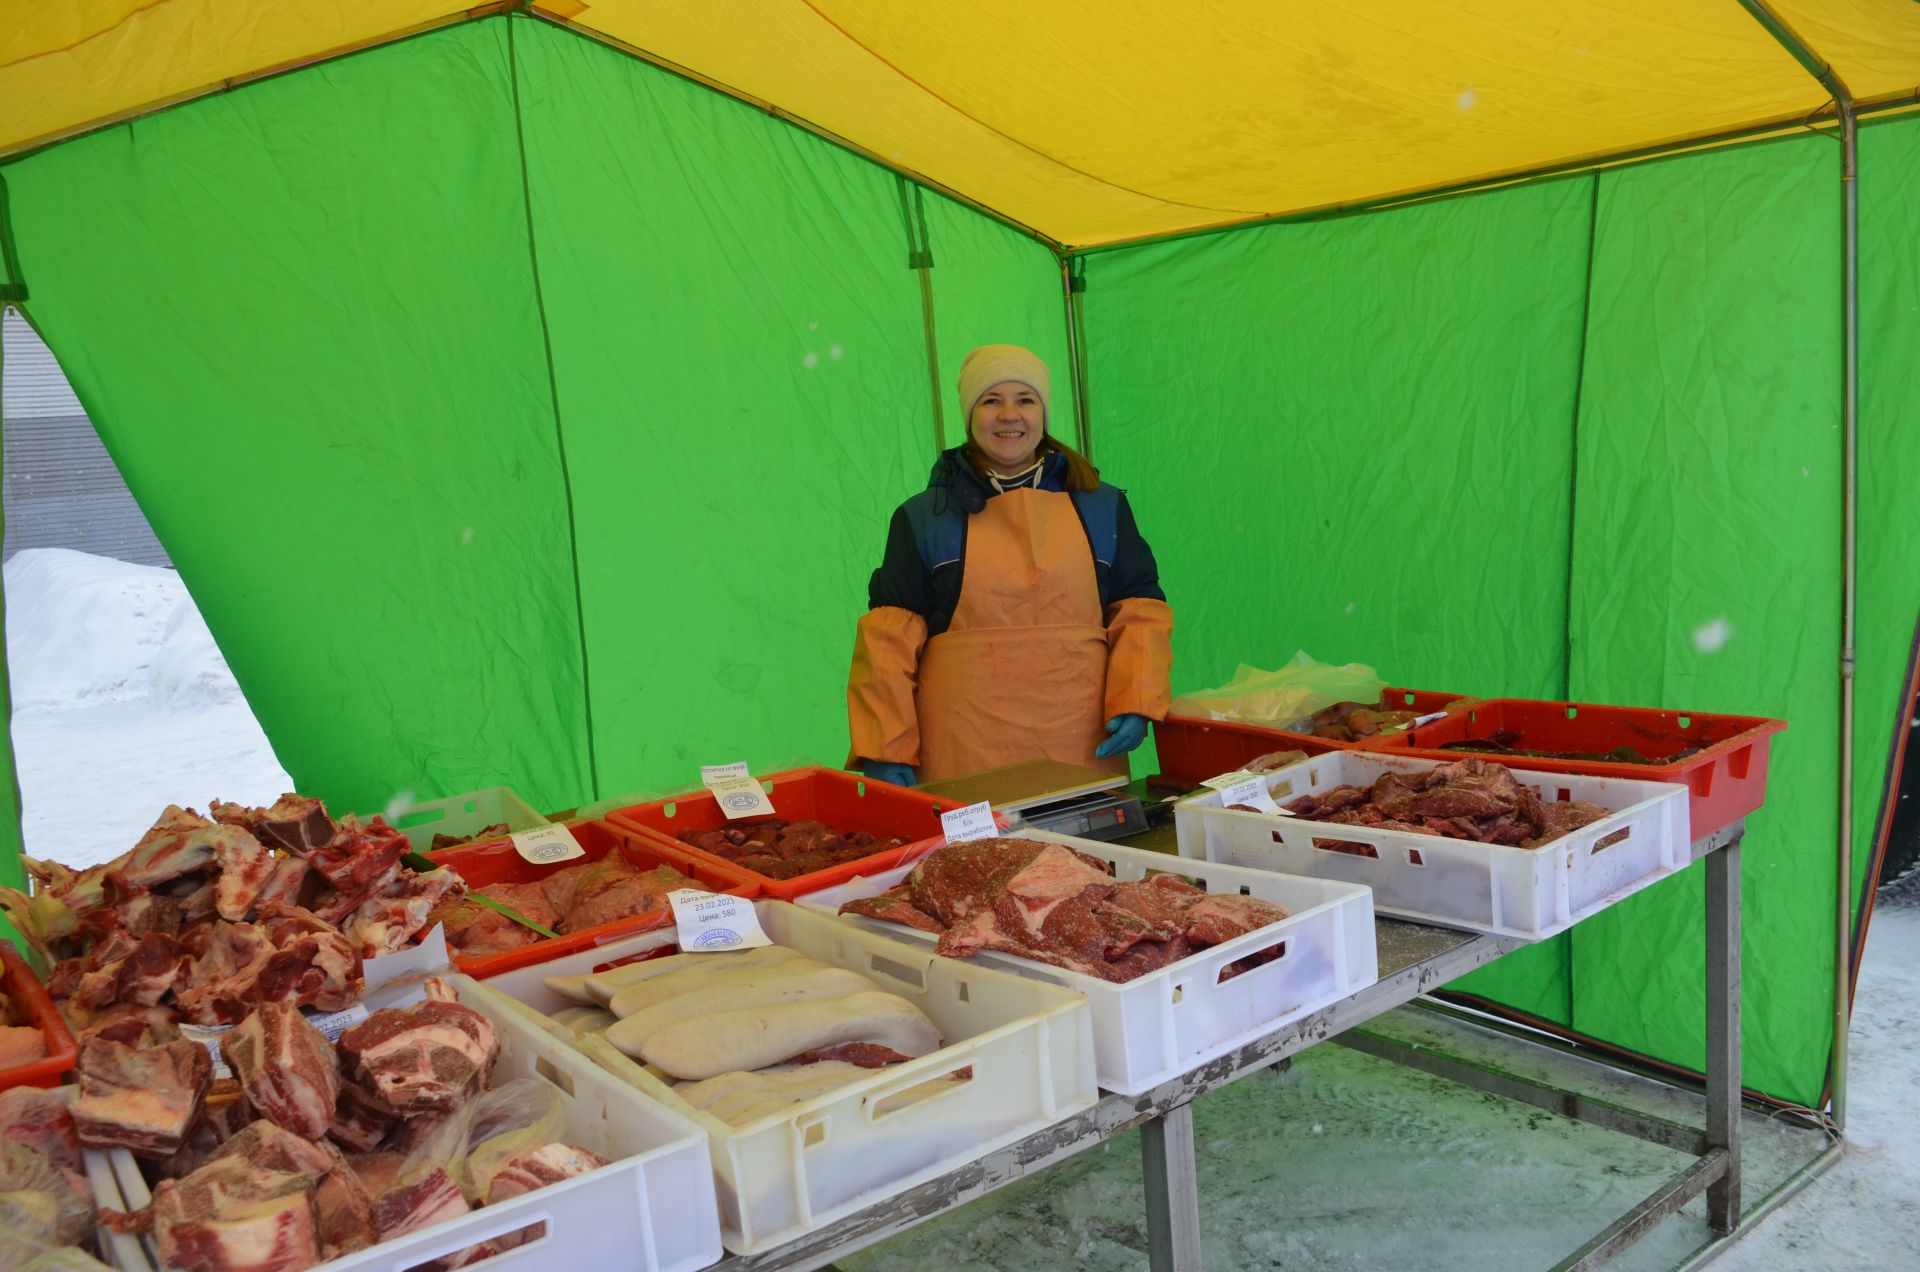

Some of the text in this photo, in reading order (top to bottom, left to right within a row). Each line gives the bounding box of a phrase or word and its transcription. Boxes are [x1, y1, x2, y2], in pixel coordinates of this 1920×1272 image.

[947, 833, 961, 843] Дата
[680, 896, 699, 904] Дата
[694, 897, 735, 912] 23.02.2023
[699, 908, 736, 923] Цена: 580
